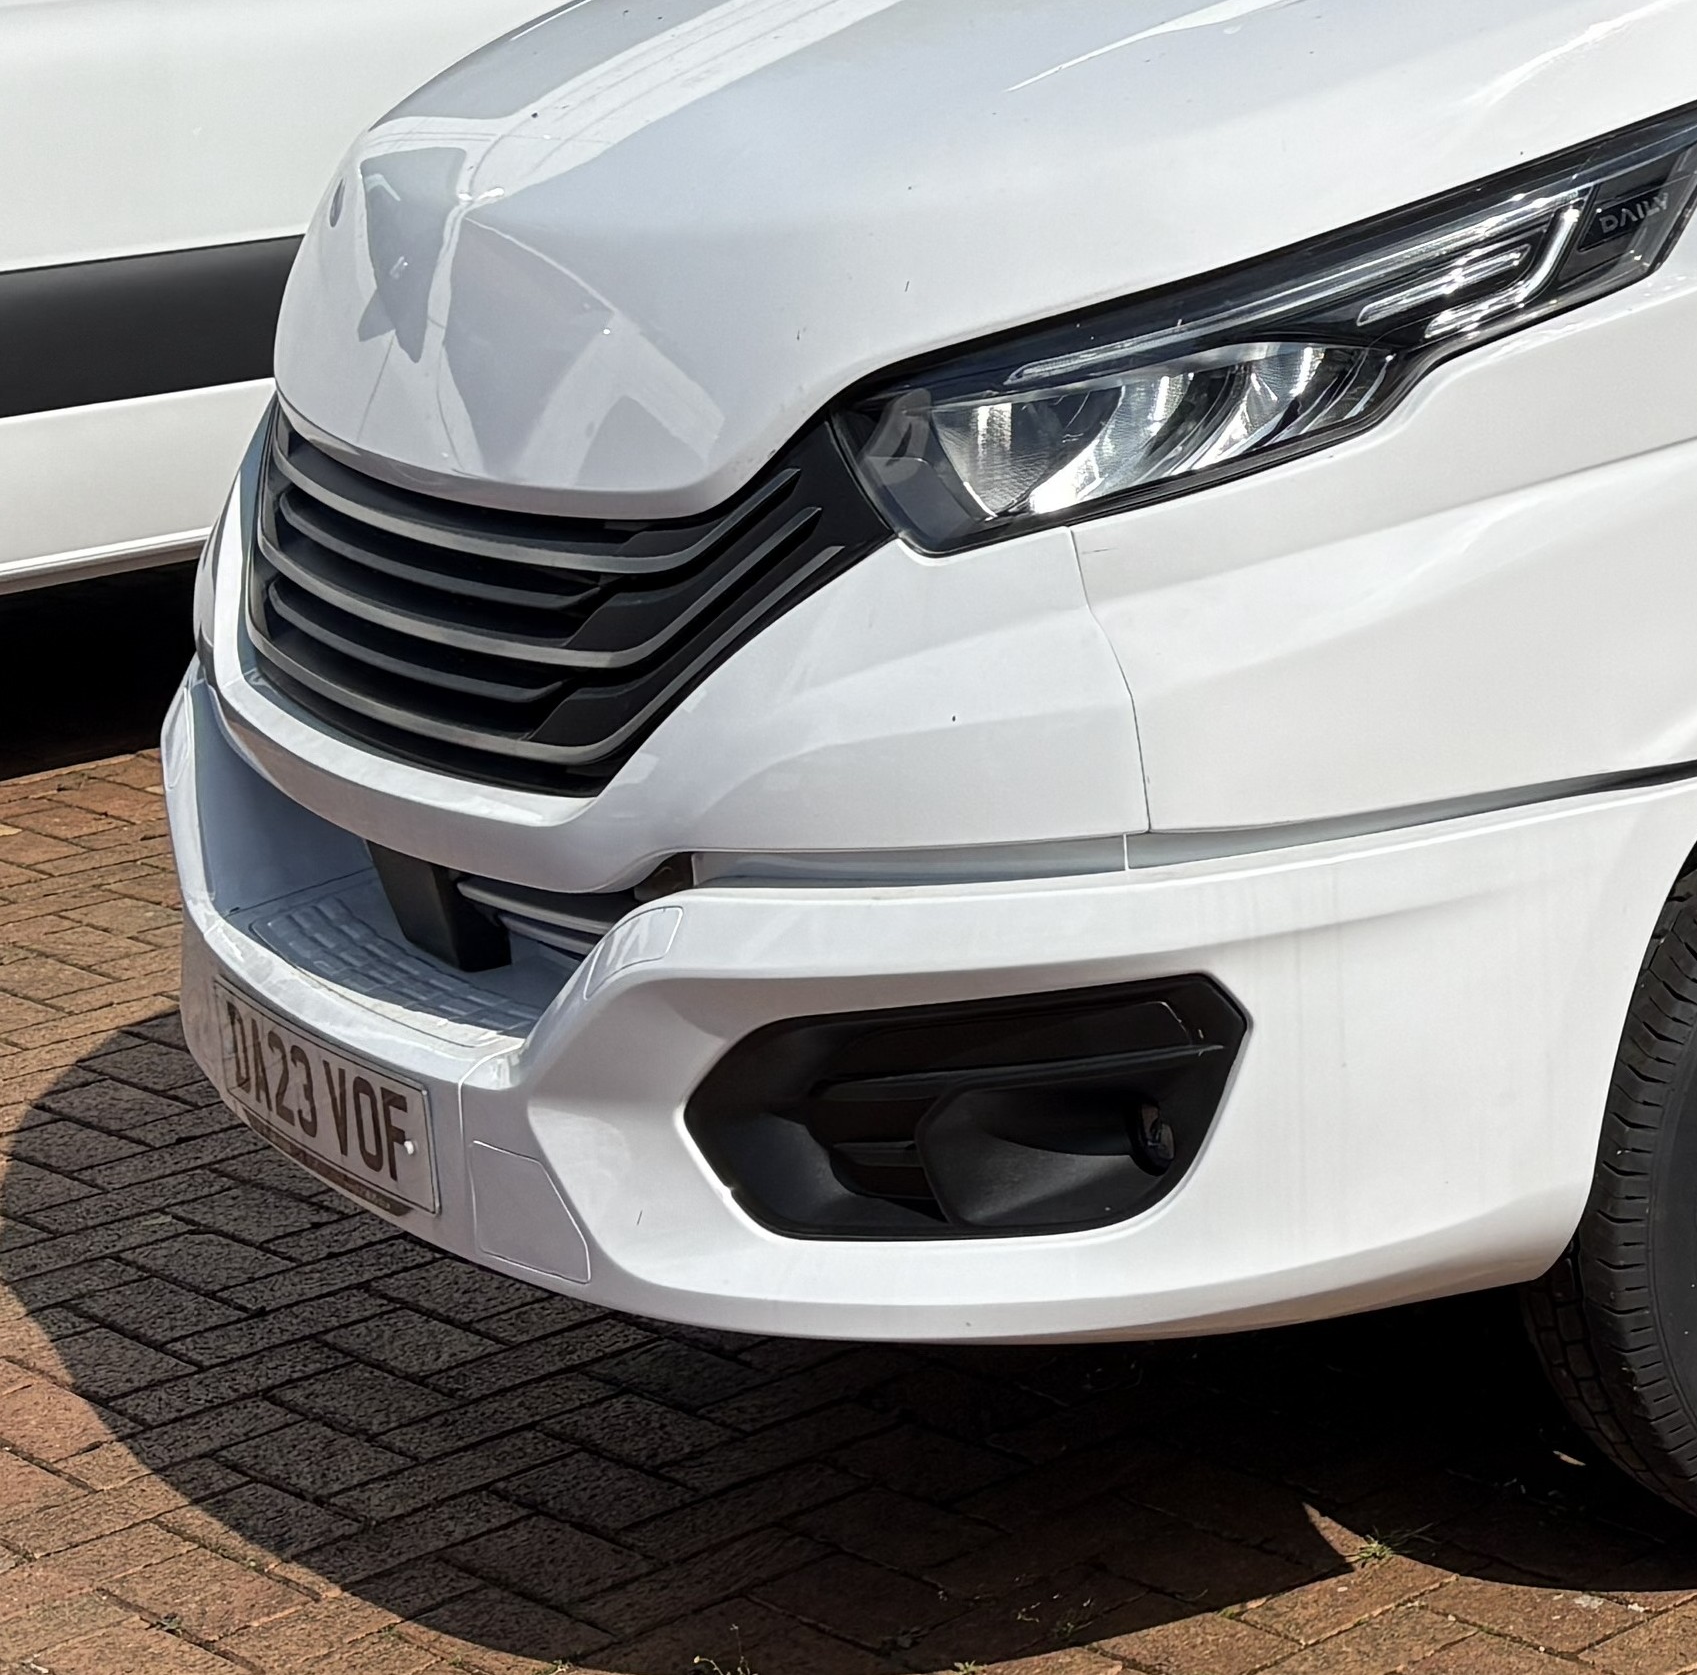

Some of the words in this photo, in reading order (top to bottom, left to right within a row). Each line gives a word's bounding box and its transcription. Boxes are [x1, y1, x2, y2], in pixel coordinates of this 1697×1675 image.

[1599, 192, 1669, 234] DAILY
[226, 1000, 317, 1139] DA23
[323, 1060, 408, 1181] VOF
